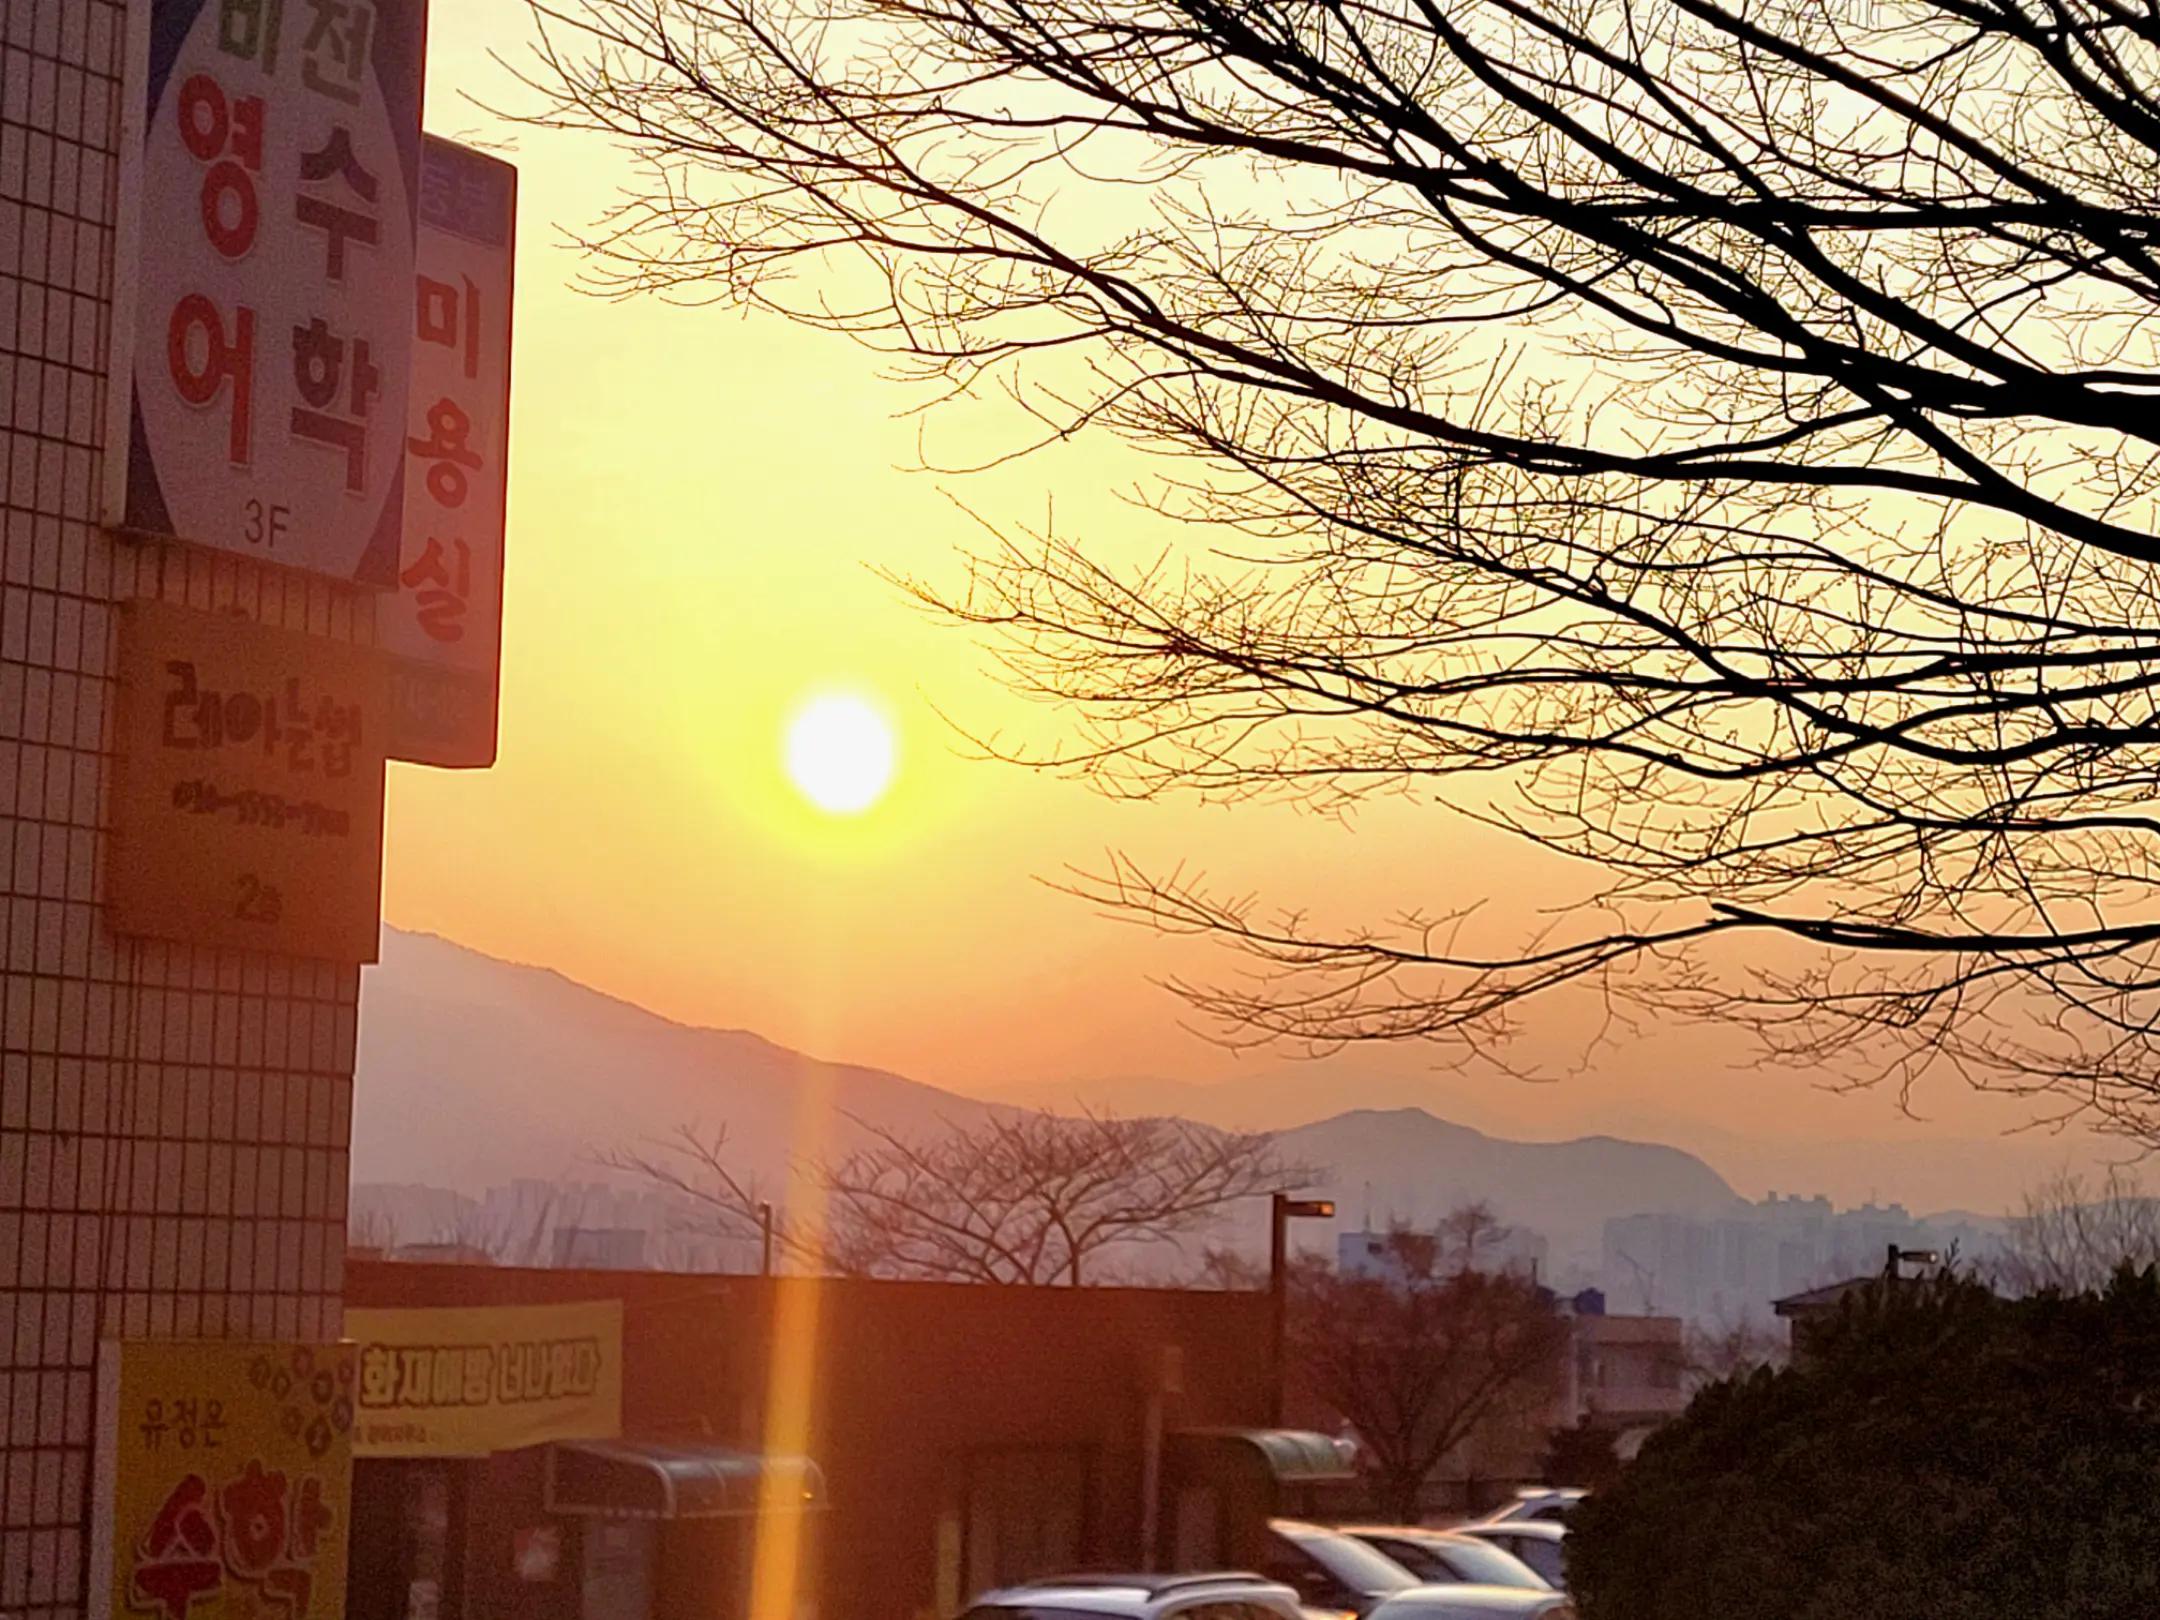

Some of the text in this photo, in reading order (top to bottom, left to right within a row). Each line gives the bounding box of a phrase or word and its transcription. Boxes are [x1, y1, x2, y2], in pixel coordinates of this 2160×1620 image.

[167, 73, 268, 469] 영어
[291, 125, 380, 496] 수학
[244, 498, 291, 549] 3F
[402, 273, 484, 642] 미용실
[359, 1342, 495, 1410] 화재예방
